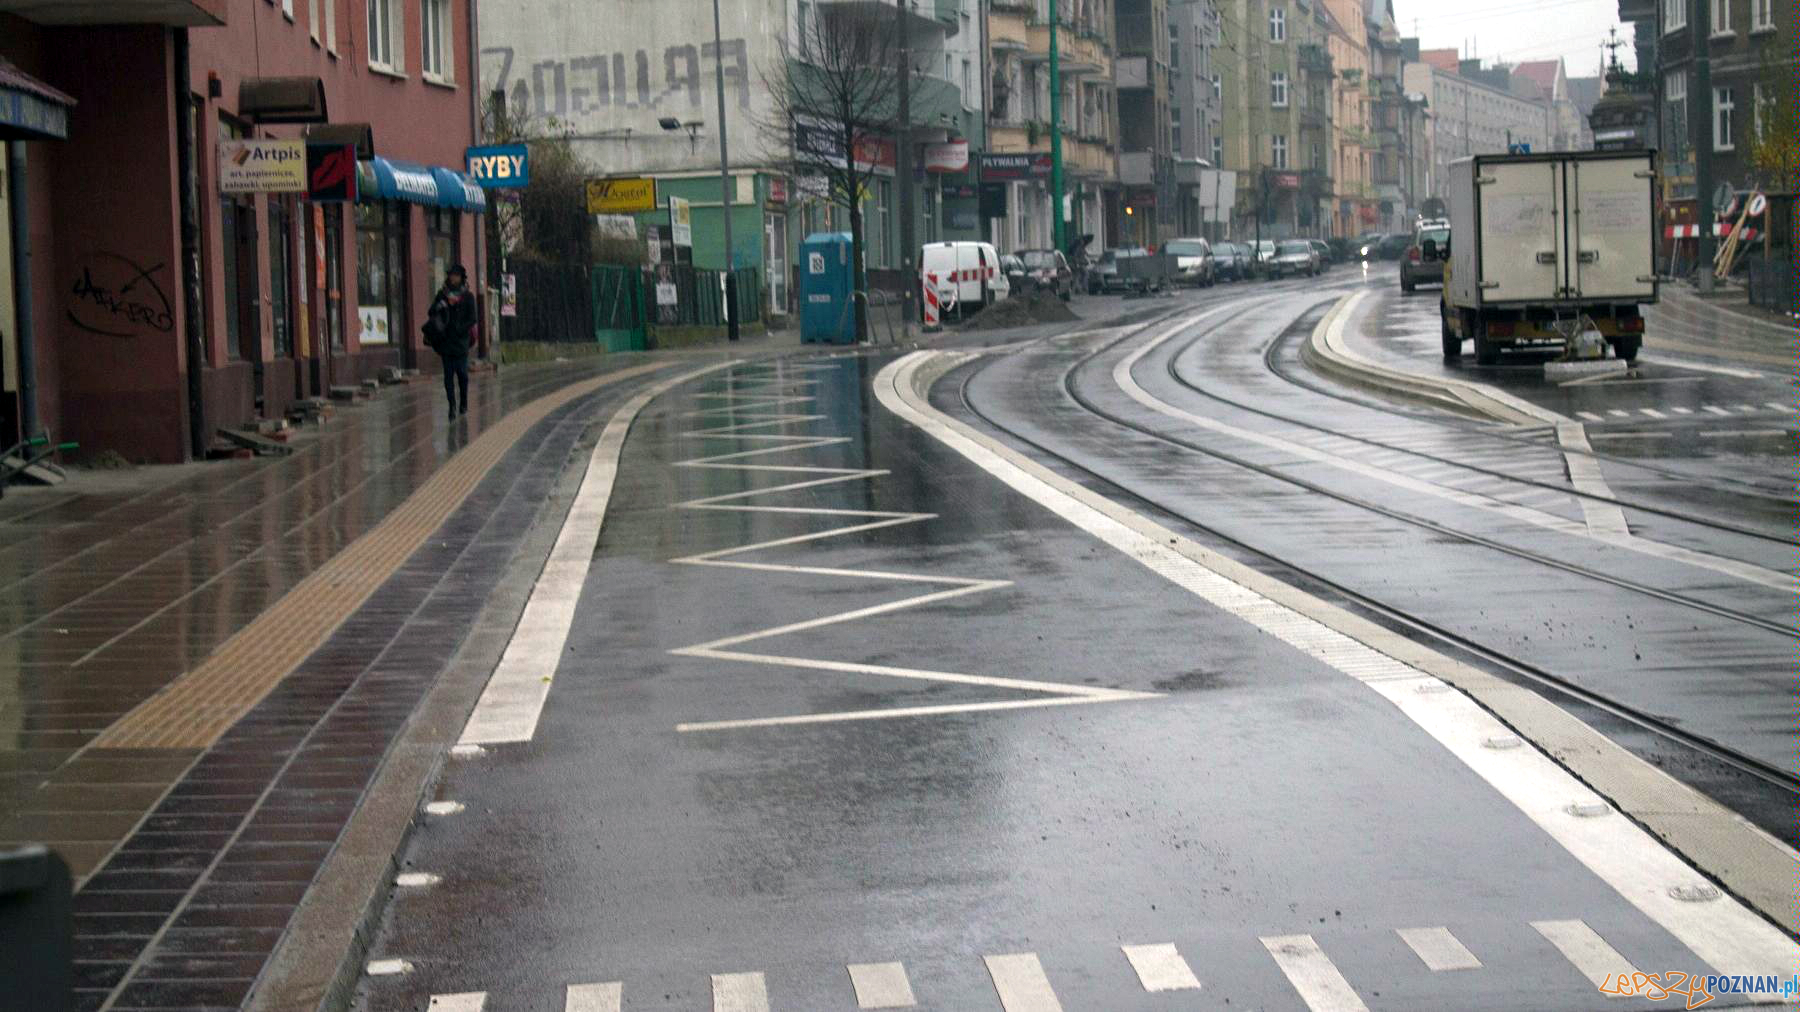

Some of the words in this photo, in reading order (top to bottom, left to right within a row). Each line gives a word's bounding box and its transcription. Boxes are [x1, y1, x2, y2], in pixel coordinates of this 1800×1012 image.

[253, 147, 301, 163] Artpis
[982, 157, 1029, 168] PŁYWALNIA
[469, 155, 525, 179] RYBY
